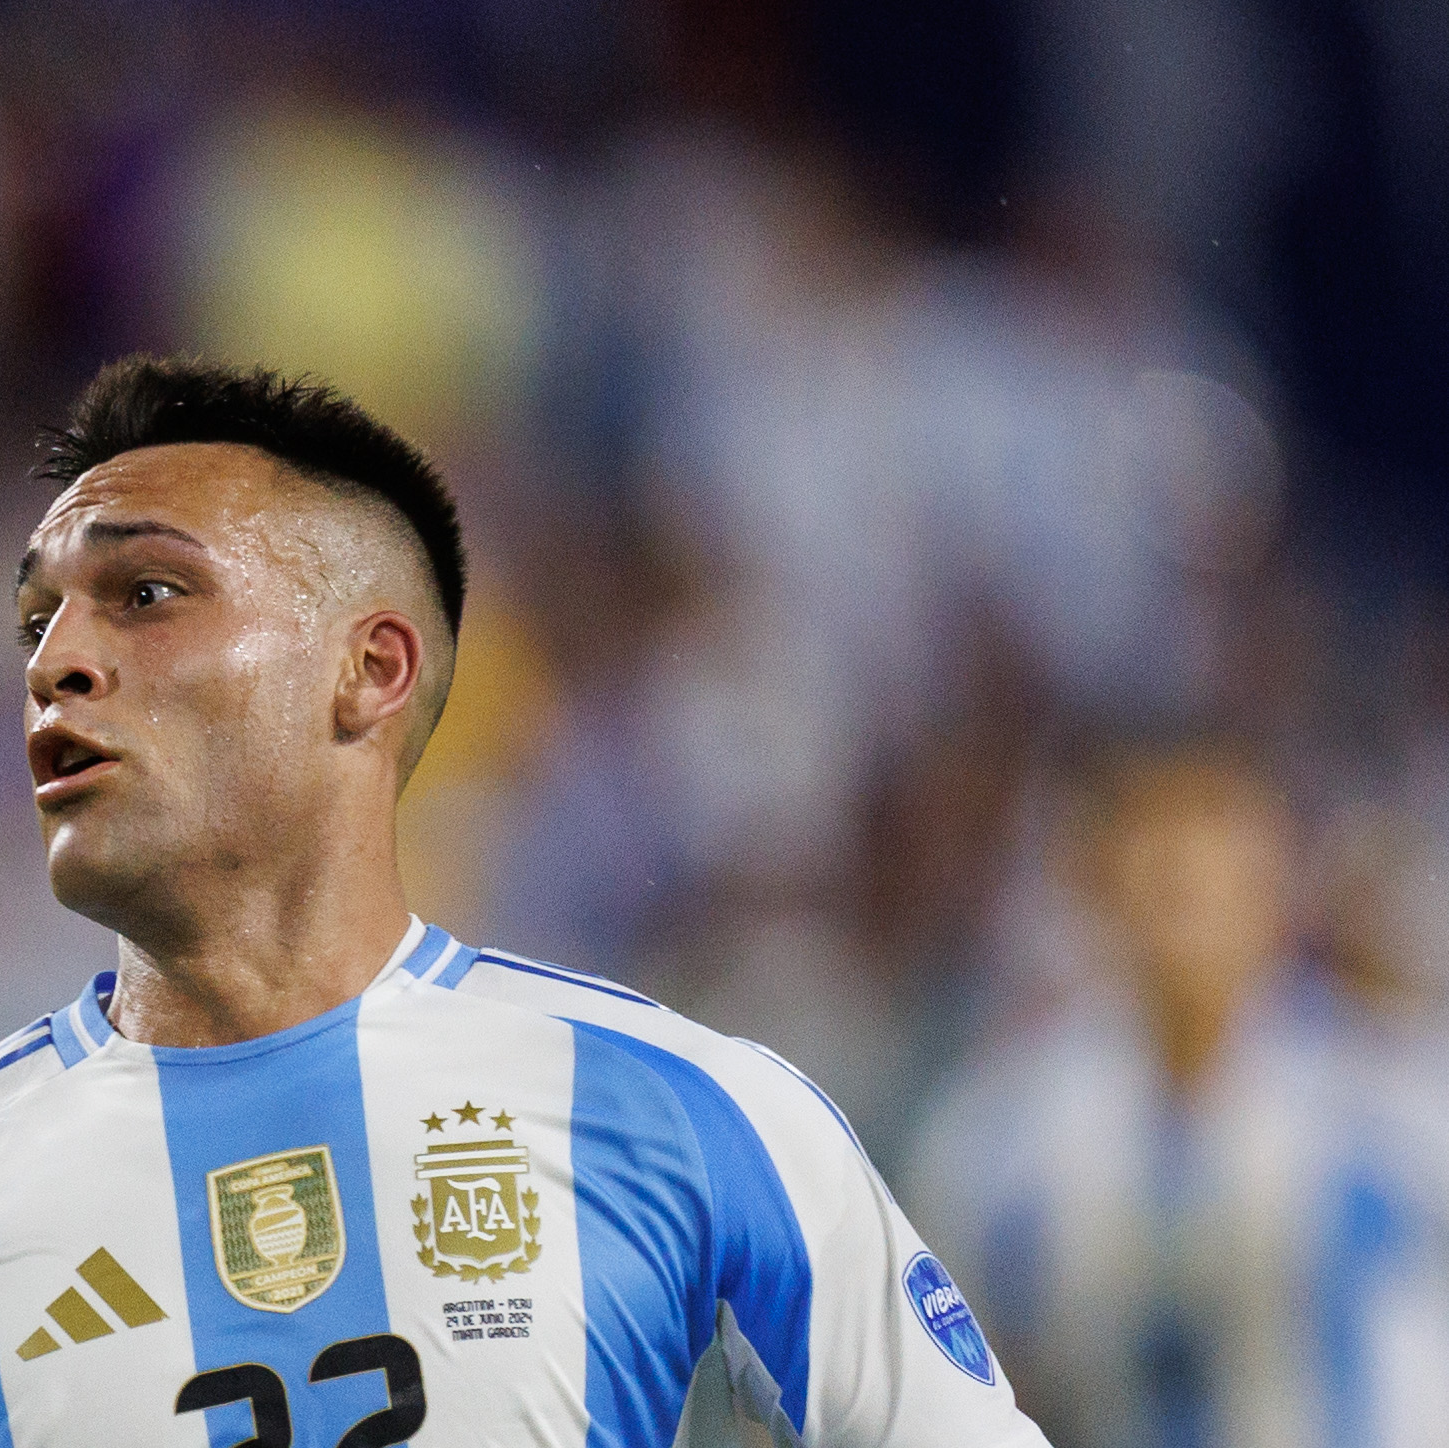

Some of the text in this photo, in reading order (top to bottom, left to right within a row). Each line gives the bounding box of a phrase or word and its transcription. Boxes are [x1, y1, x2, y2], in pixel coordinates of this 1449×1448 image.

[439, 1176, 516, 1242] AFA
[463, 1314, 474, 1326] DE
[479, 1313, 504, 1324] JUNIO
[508, 1312, 533, 1323] 2024
